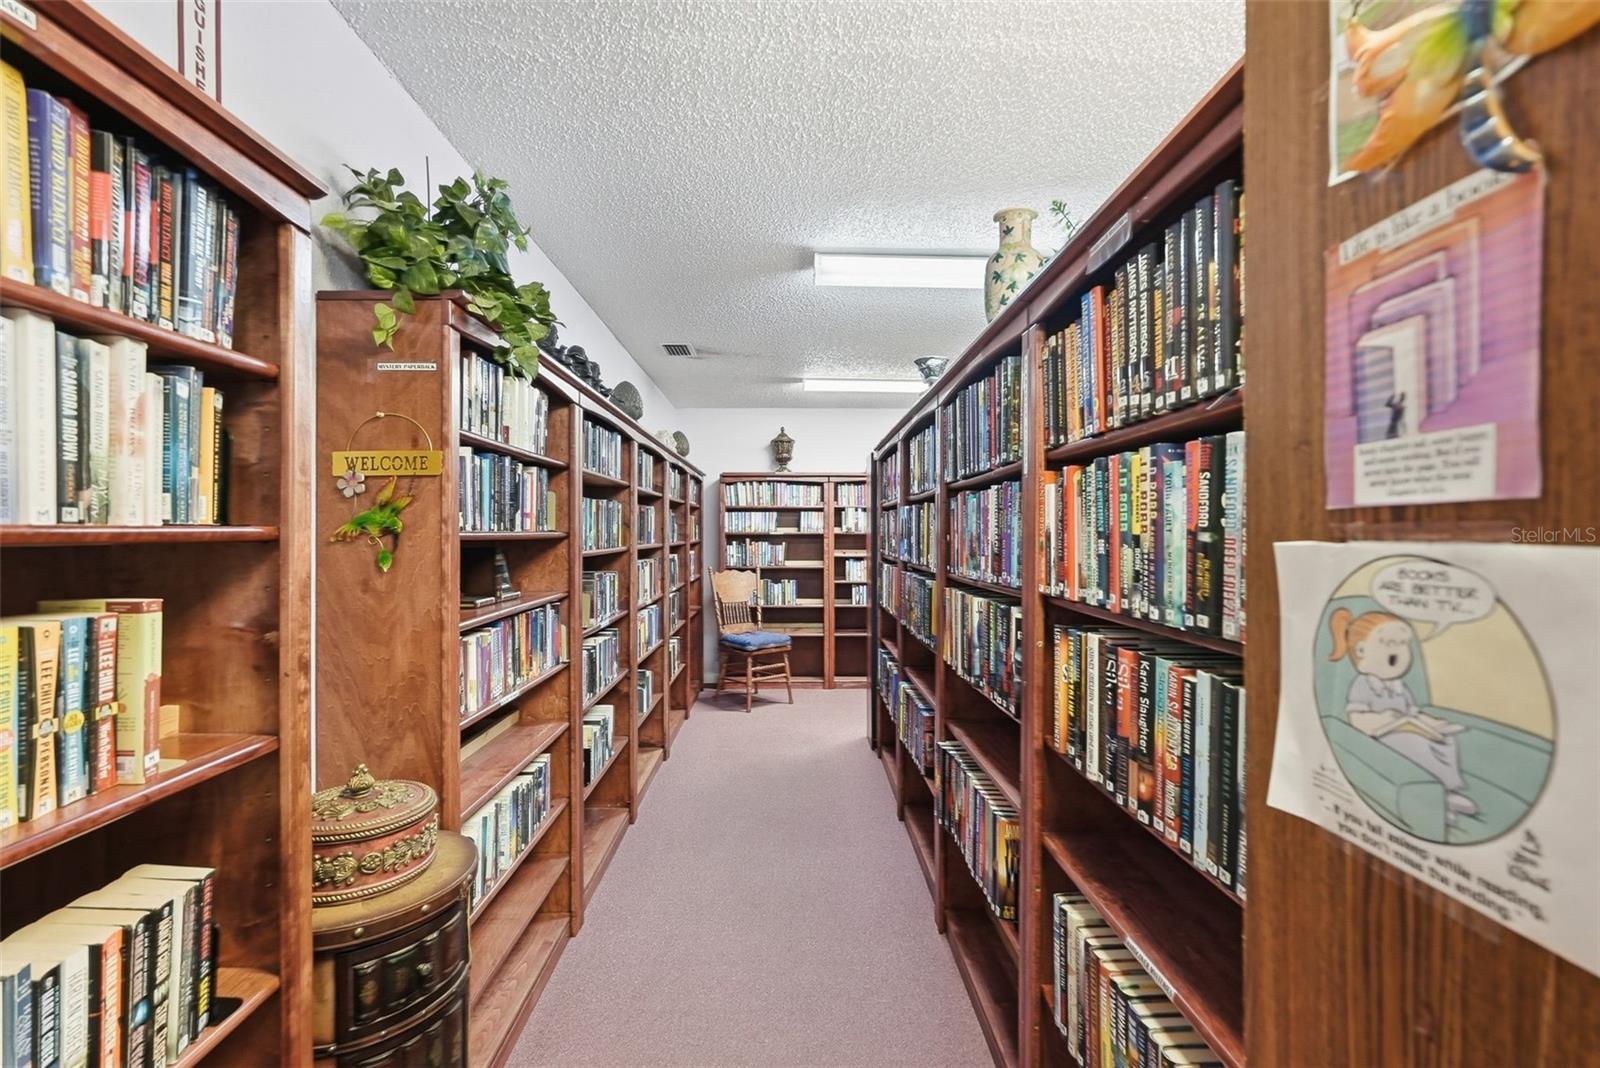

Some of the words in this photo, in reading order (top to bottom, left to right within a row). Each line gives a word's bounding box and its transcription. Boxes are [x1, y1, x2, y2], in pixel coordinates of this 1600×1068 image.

[52, 124, 66, 170] DAVID
[75, 134, 89, 173] DAVID
[48, 174, 66, 245] BALDACCI
[75, 176, 89, 241] BALDACCI
[161, 183, 172, 213] DAVID
[161, 215, 171, 261] BALDACCI
[1128, 263, 1137, 298] JAMES
[1139, 254, 1148, 291] JAMES
[1128, 299, 1137, 364] PATTERSON
[1139, 291, 1149, 359] PATTERSON
[1154, 319, 1163, 369] PATTERSON
[62, 369, 78, 415] SANDRA
[62, 418, 78, 462] BROWN
[344, 455, 429, 472] WELCOME
[1198, 472, 1211, 528] SANDFORD
[1224, 459, 1239, 529] SANDFORD
[1397, 567, 1451, 582] BOOKS
[1411, 583, 1480, 600] BETTER
[1389, 595, 1430, 609] THAN
[40, 660, 53, 680] LEE
[67, 647, 80, 663] LEE
[98, 648, 113, 668] LEE
[67, 682, 79, 709] CHILD
[98, 669, 114, 701] CHILD
[1139, 660, 1150, 694] Karin
[1168, 671, 1177, 699] KARIN
[39, 682, 52, 715] CHILD
[1138, 697, 1150, 754] Slaughter
[1166, 700, 1178, 770] SLAUGHTER
[39, 741, 50, 800] PERSONAL
[1433, 853, 1473, 883] while
[41, 987, 55, 1036] HARLAN
[66, 970, 83, 1019] HARLAN
